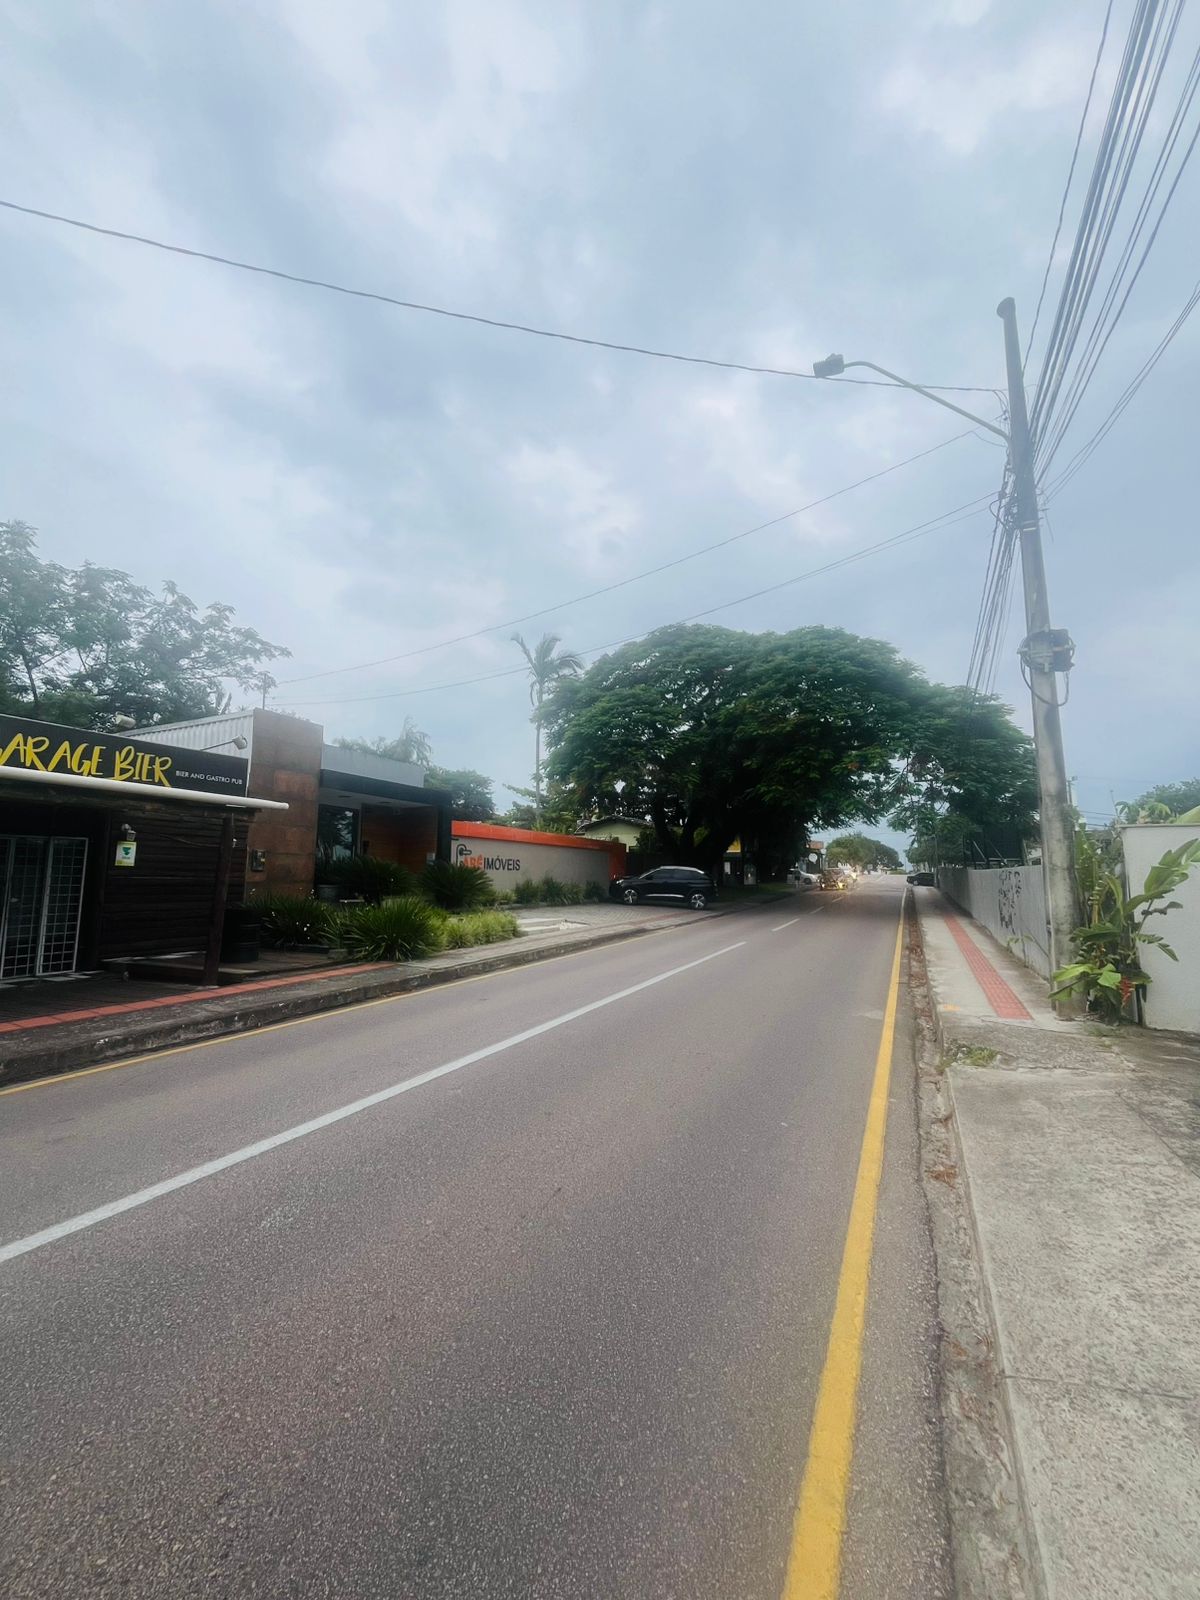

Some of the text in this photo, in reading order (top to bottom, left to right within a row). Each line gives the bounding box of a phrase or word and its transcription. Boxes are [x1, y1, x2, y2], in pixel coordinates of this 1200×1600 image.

[0, 732, 173, 788] ARAGE BIER
[175, 770, 189, 778] BIER
[206, 774, 230, 783] GASTRO
